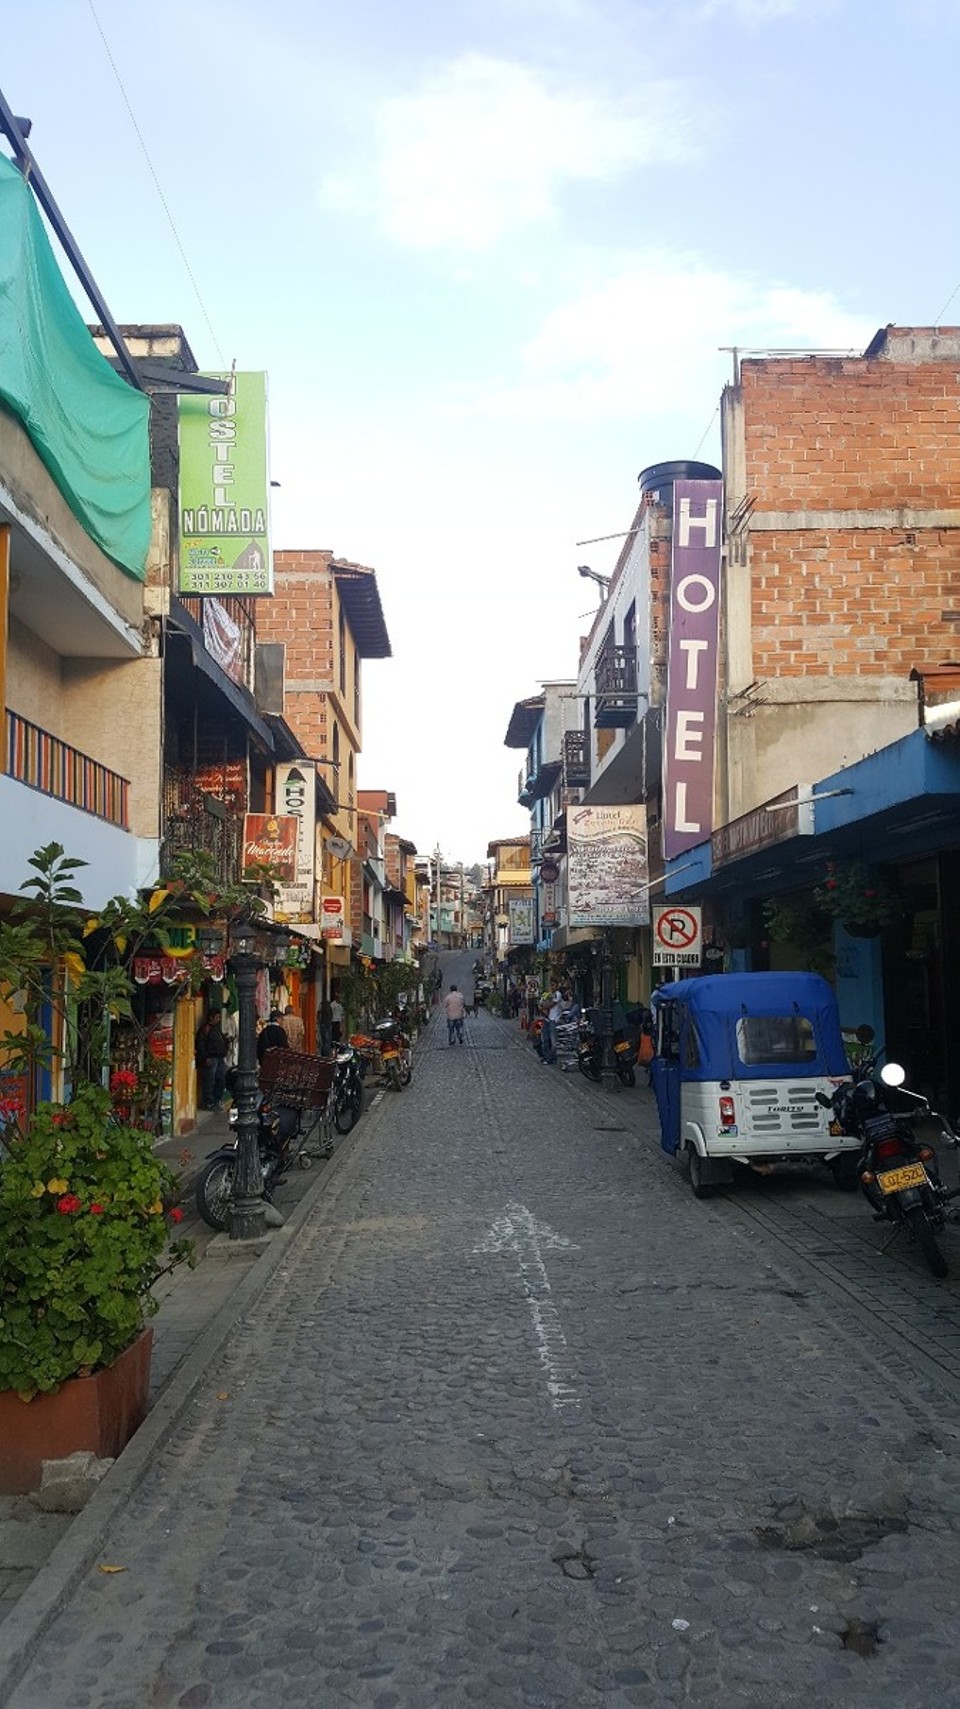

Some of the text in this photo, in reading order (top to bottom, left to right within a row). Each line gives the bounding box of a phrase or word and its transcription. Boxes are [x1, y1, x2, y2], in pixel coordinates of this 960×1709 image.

[183, 504, 266, 533] NÓMADA
[674, 498, 718, 833] HOTEL
[662, 953, 675, 964] ESTA
[676, 953, 699, 965] CUADRA
